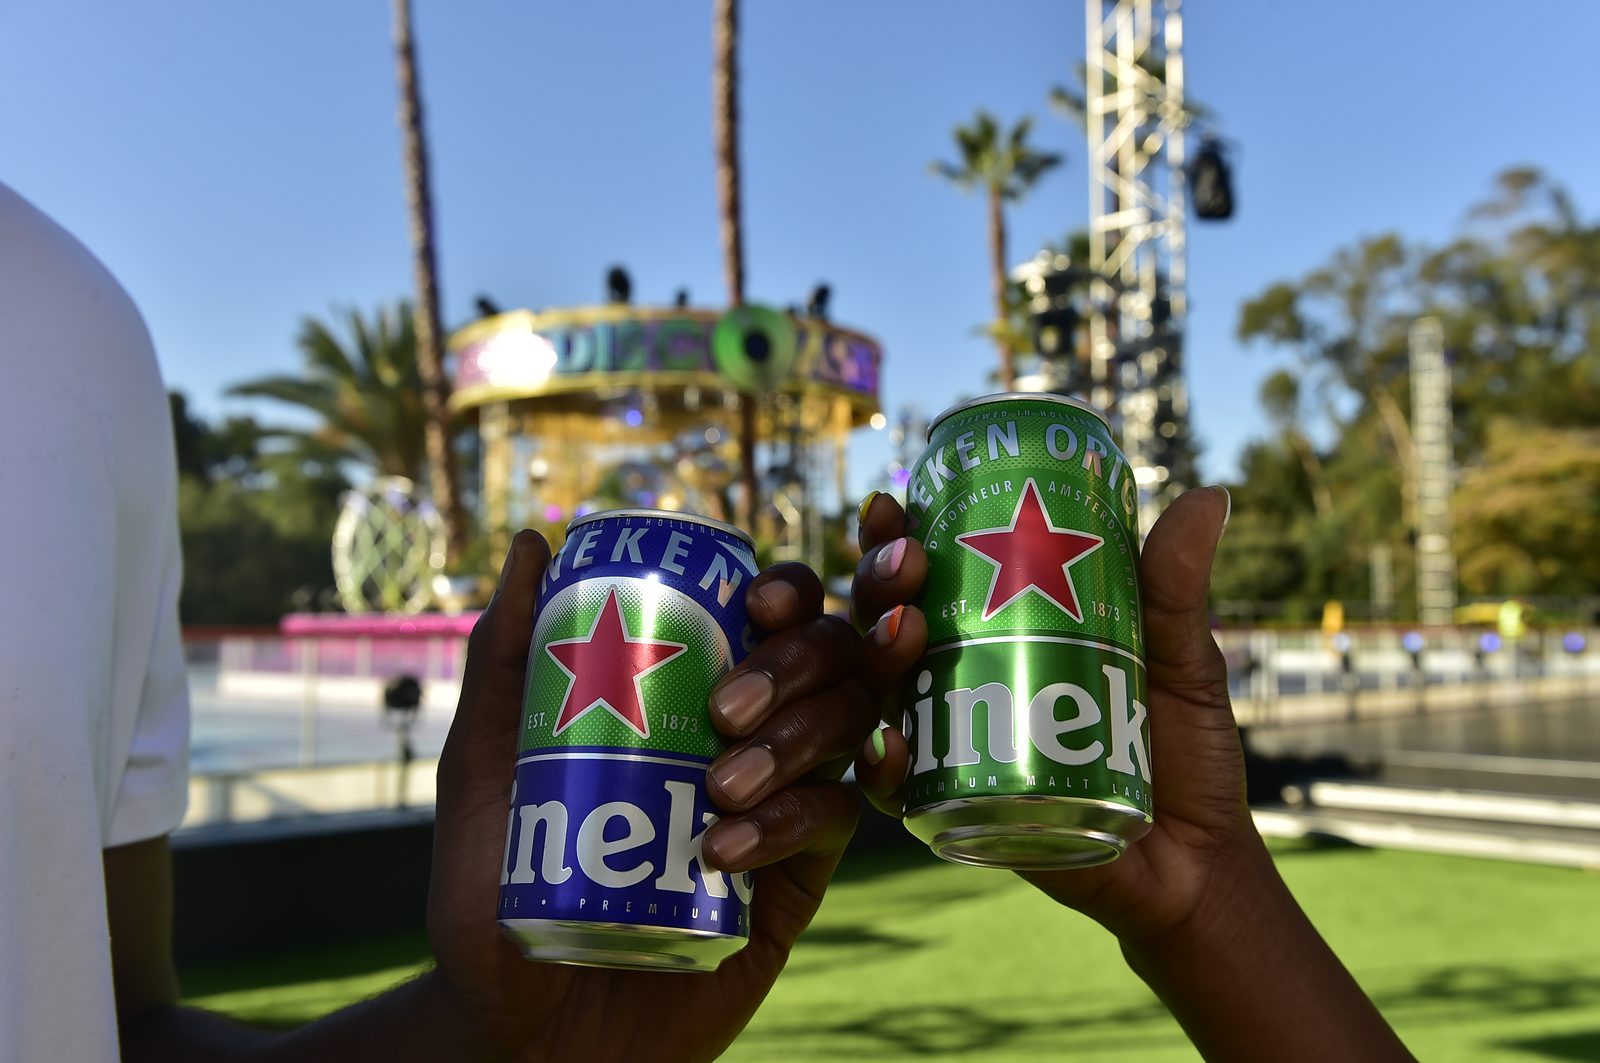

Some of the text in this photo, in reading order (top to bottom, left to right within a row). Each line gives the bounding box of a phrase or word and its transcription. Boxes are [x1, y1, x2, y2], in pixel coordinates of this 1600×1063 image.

[1016, 409, 1031, 417] IN
[616, 518, 632, 527] IN
[645, 517, 716, 537] HOLLAND
[928, 480, 1014, 550] D'HONNEUR
[1048, 480, 1128, 555] AMSTERDAM
[942, 600, 972, 619] EST.
[1091, 600, 1121, 622] 1873
[527, 711, 548, 730] EST.
[661, 713, 699, 734] 1873
[1026, 775, 1090, 790] MALT
[579, 898, 719, 922] PREMIUM
